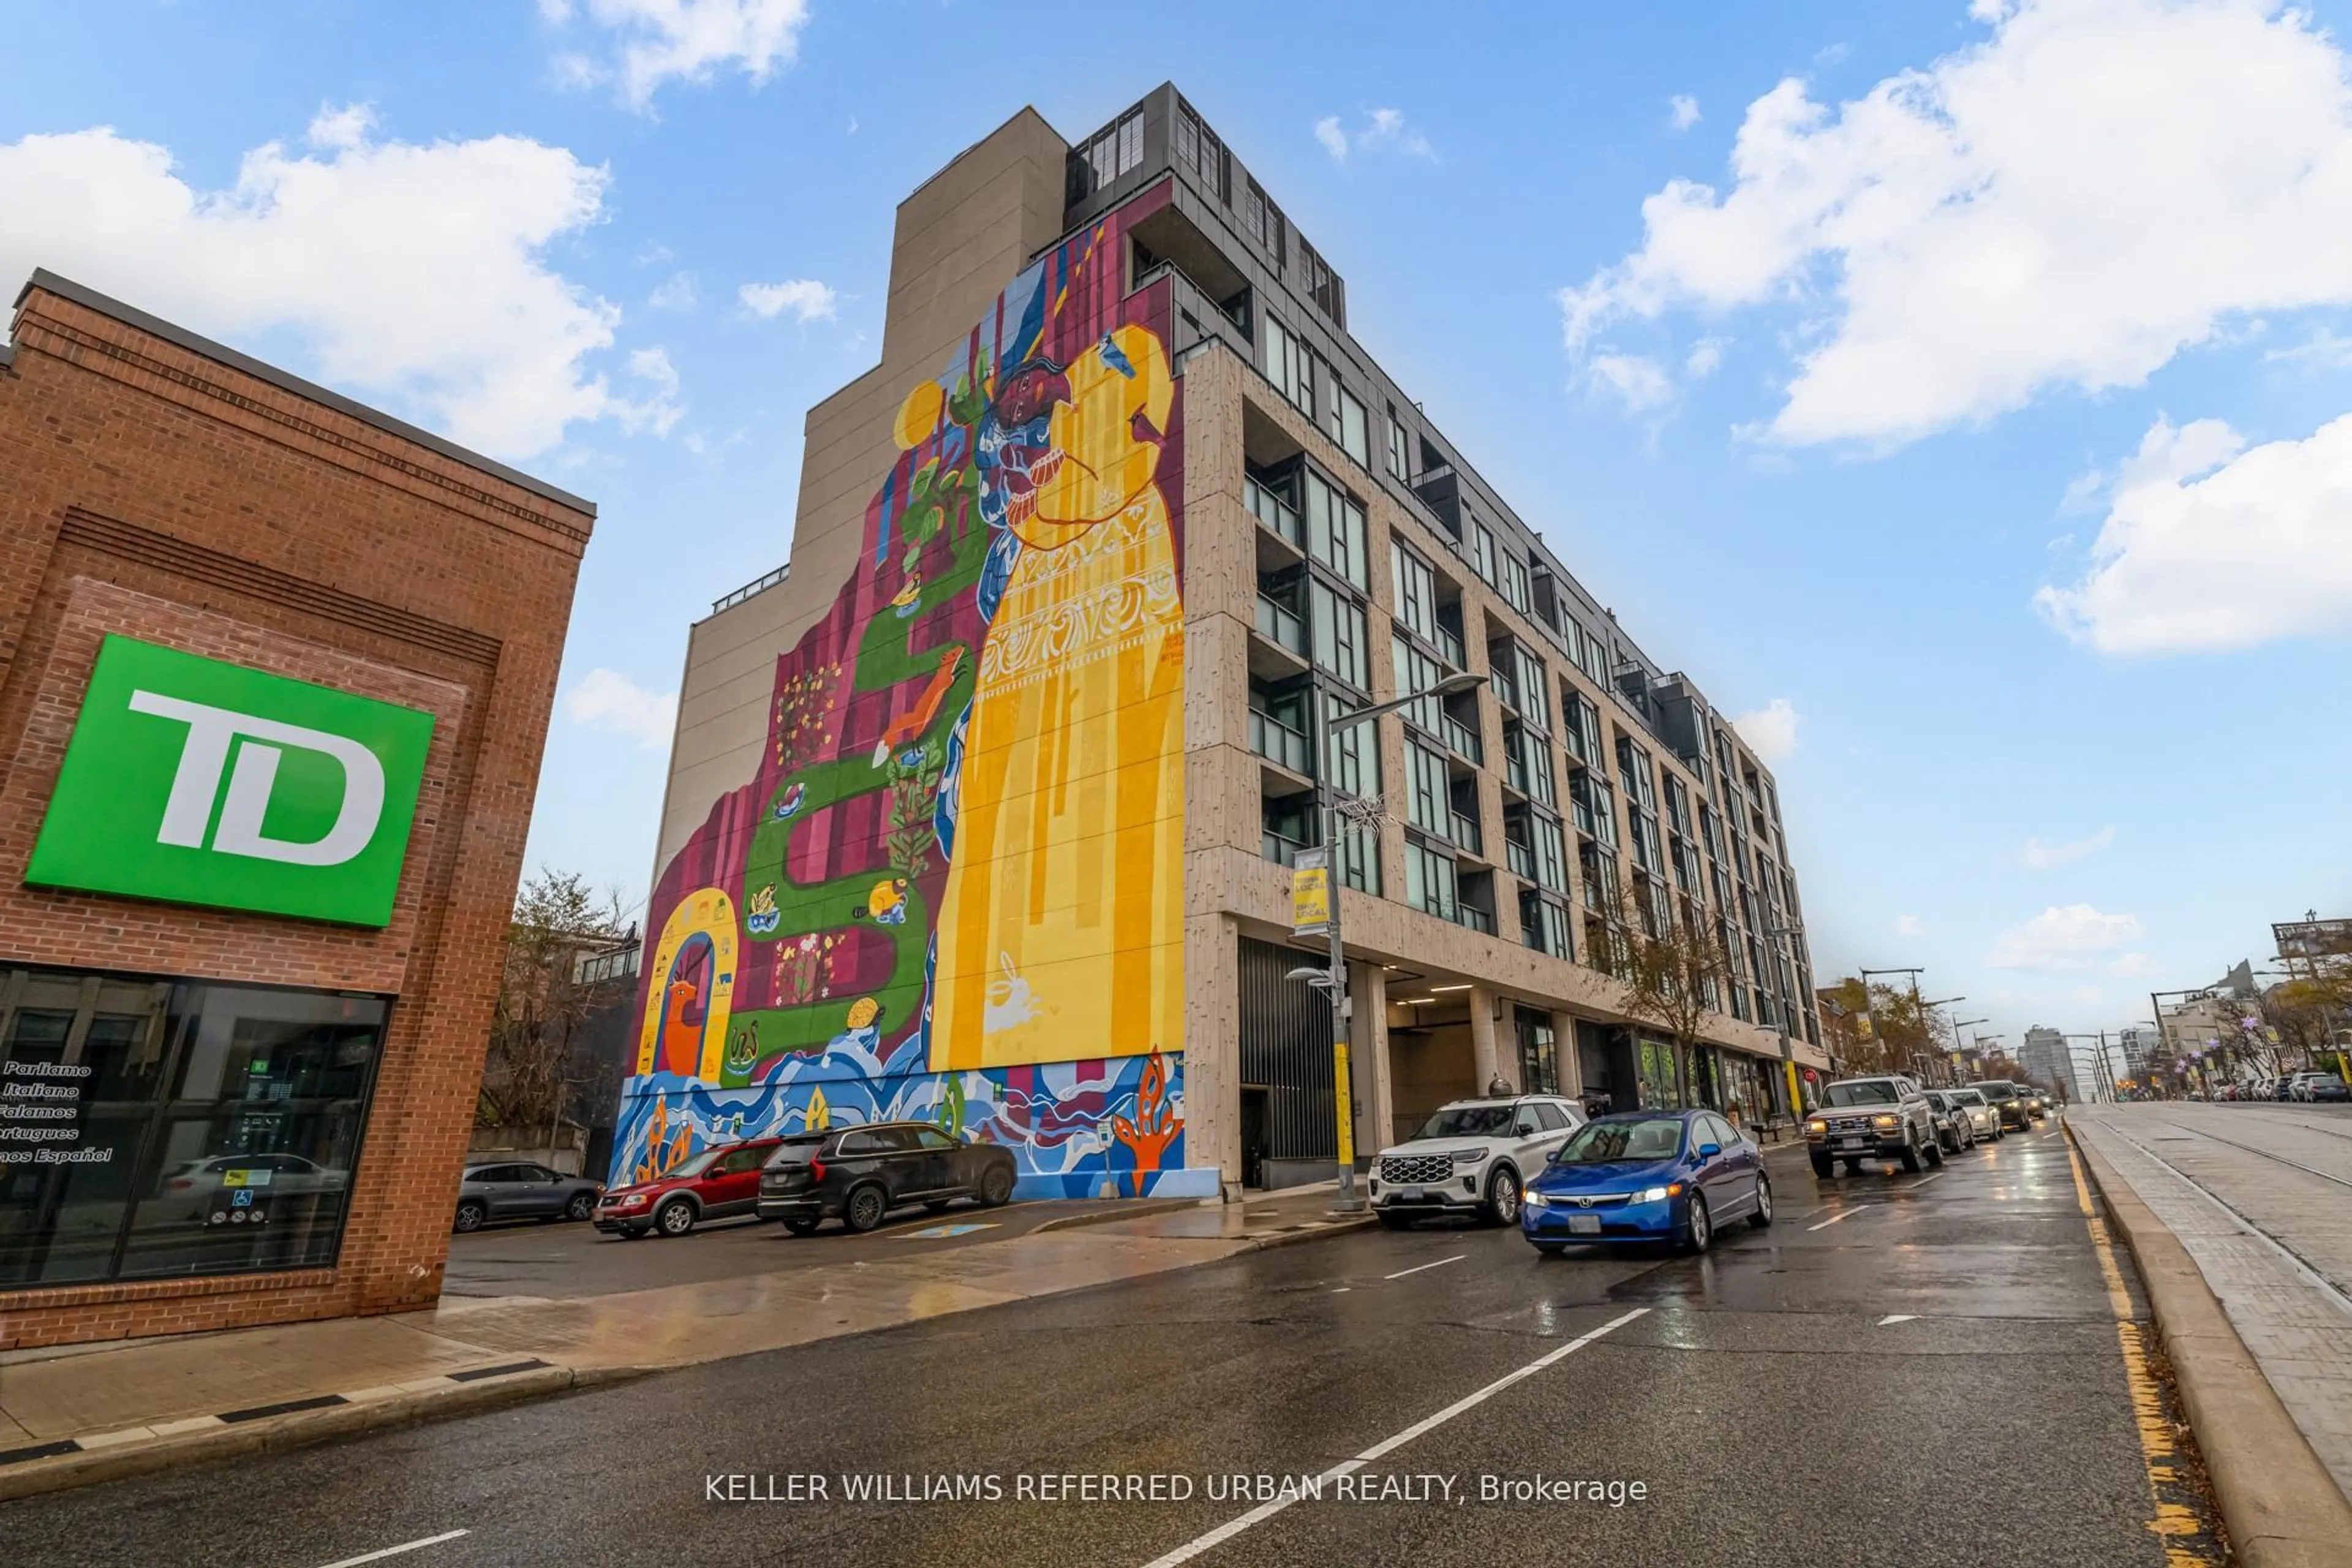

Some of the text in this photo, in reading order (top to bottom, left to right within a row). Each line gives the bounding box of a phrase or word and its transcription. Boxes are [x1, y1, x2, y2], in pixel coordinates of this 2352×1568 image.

[129, 689, 385, 866] TD
[3, 1061, 91, 1077] Parliamo
[3, 1083, 79, 1097] Italiano
[34, 1147, 113, 1164] Español
